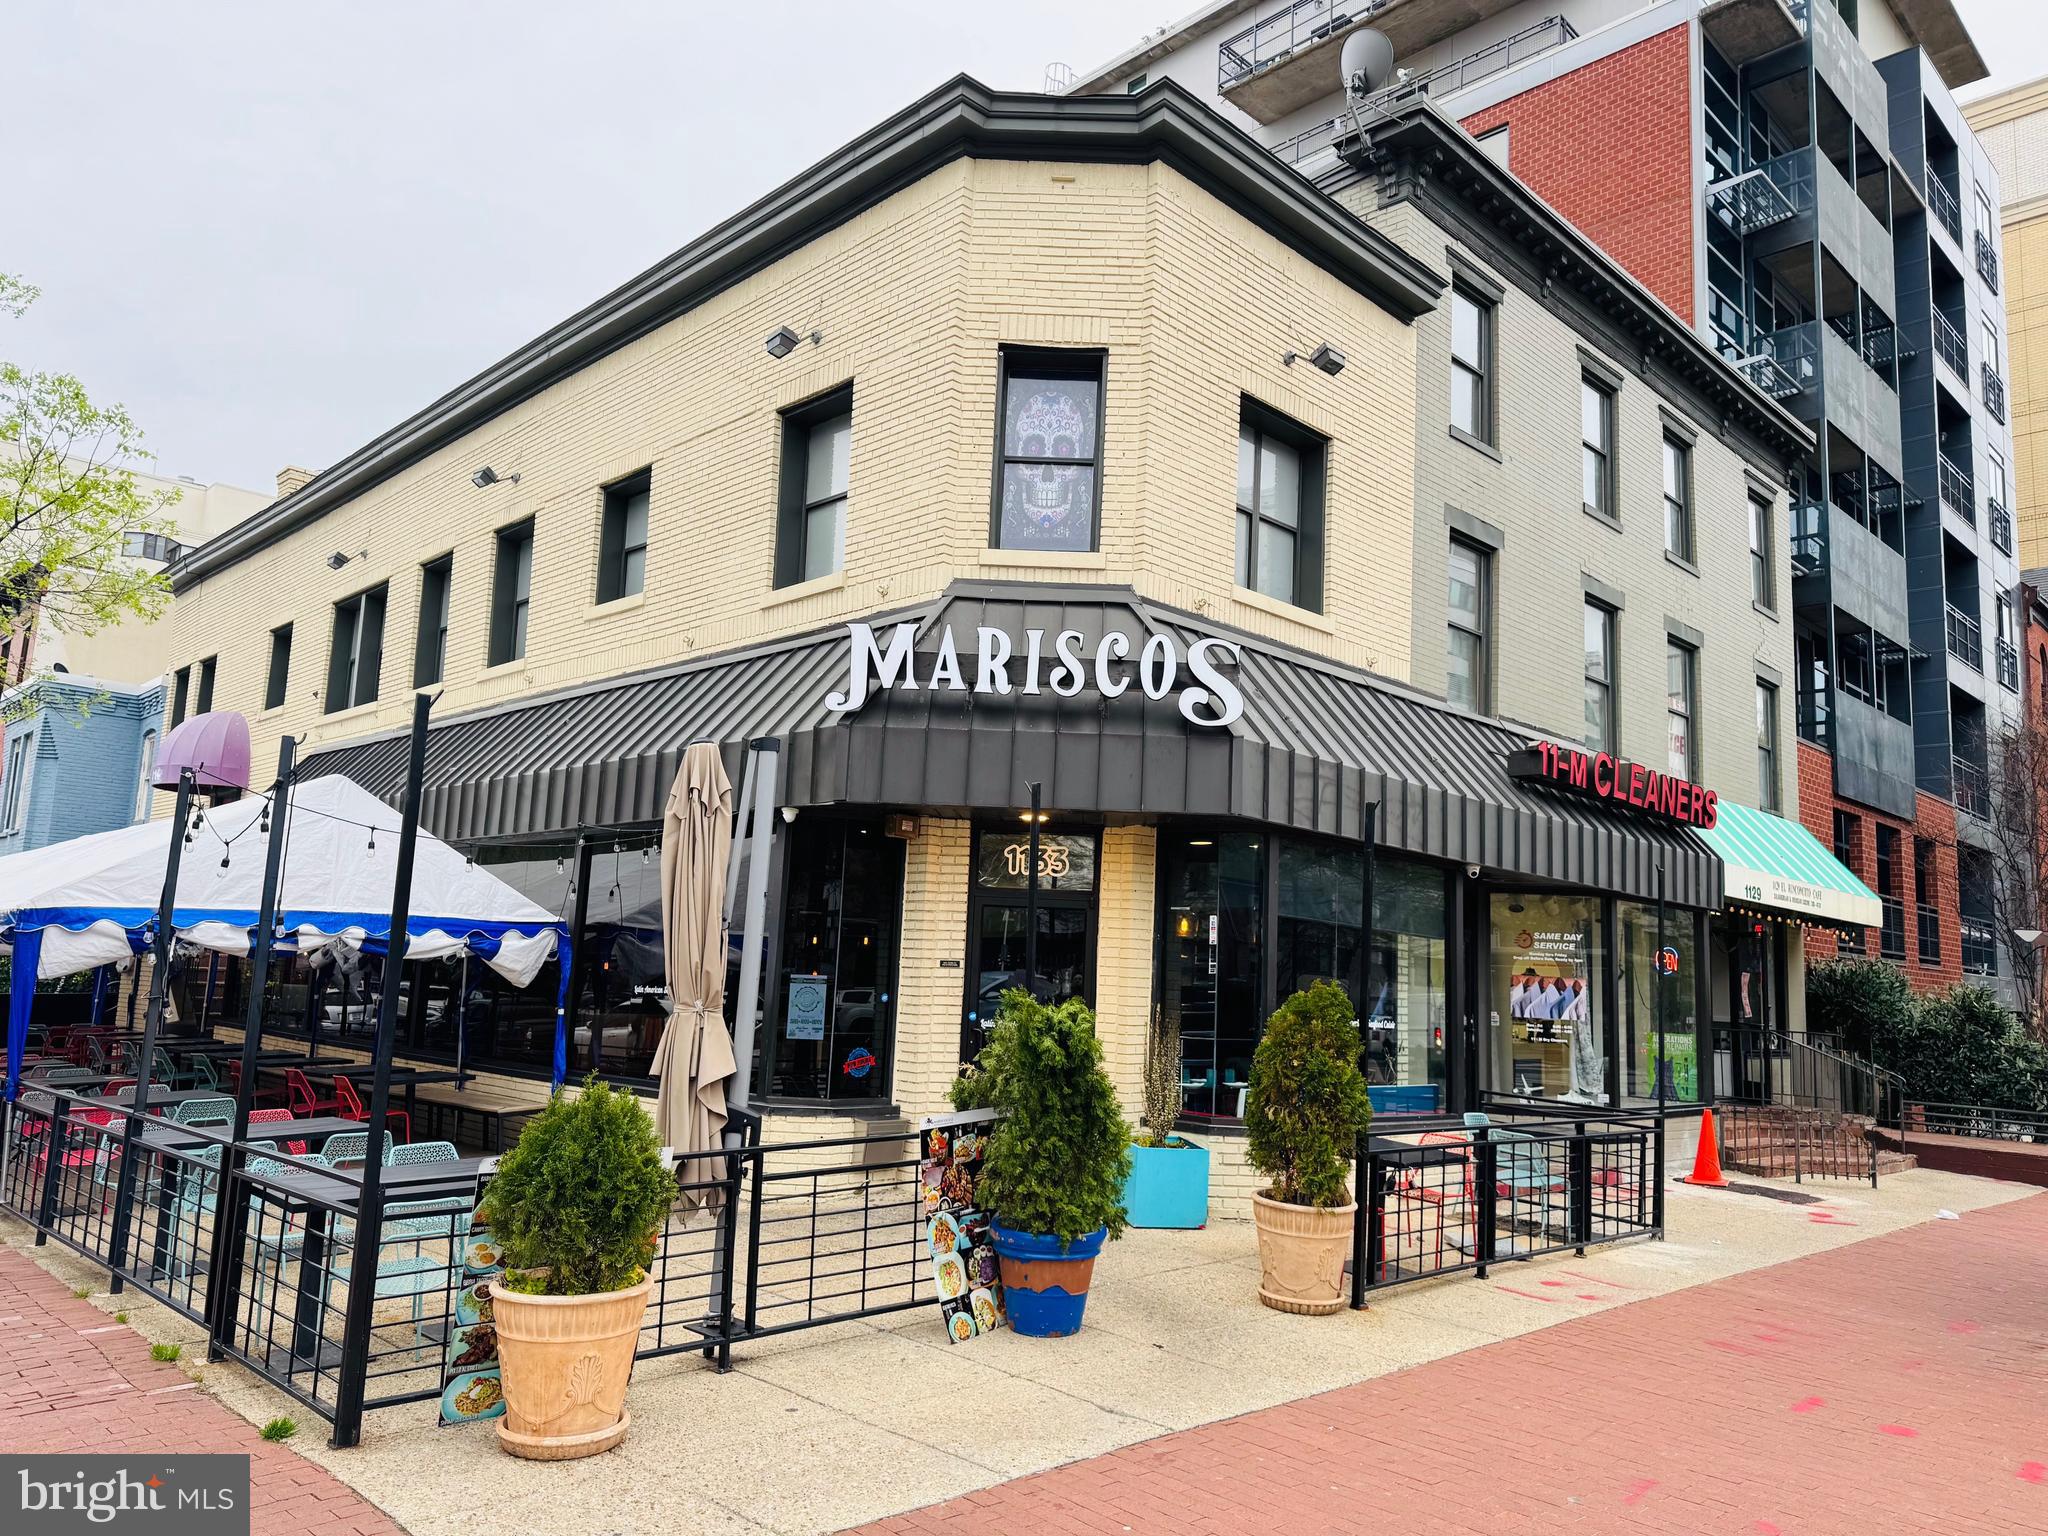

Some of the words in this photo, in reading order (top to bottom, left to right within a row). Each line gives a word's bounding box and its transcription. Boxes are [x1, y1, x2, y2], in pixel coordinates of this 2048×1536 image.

[825, 623, 1244, 726] MARISCOS
[1538, 741, 1587, 789] 11-M
[1594, 752, 1718, 830] CLEANERS
[1004, 844, 1070, 877] 1133
[1745, 884, 1761, 901] 1129
[1533, 932, 1561, 940] SAME
[1563, 933, 1583, 941] DAY
[1533, 942, 1576, 950] SERVICE
